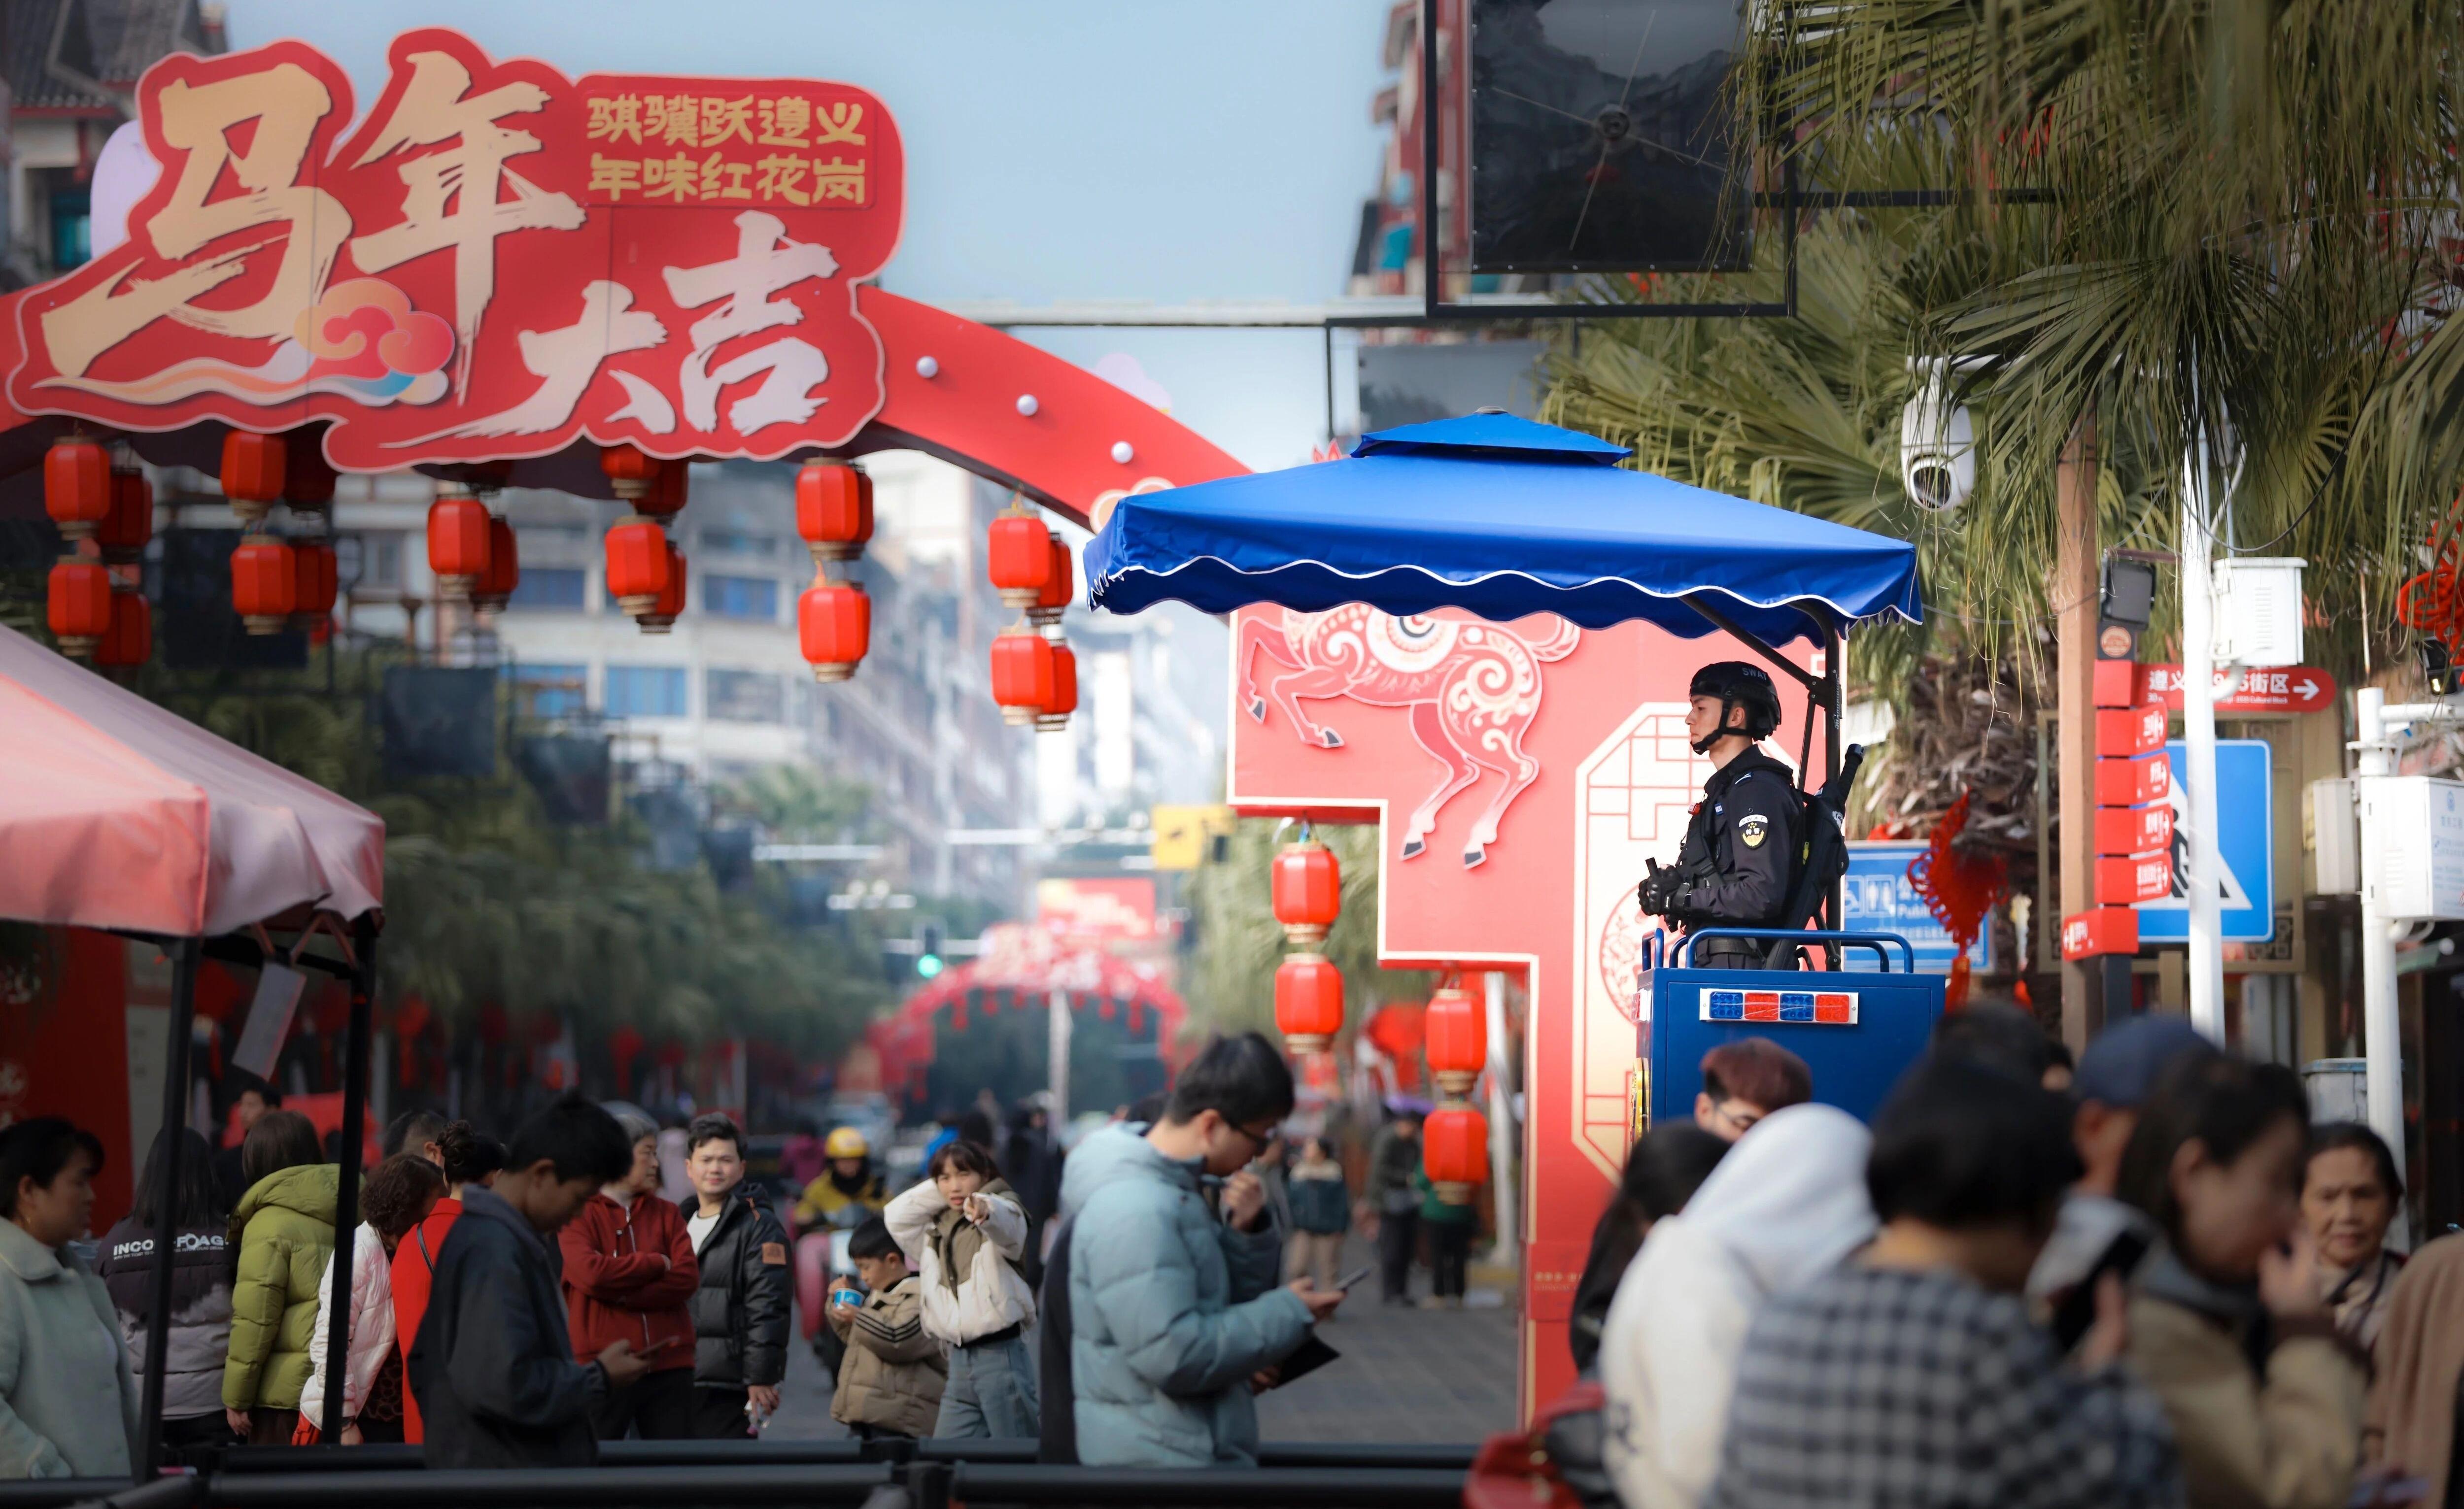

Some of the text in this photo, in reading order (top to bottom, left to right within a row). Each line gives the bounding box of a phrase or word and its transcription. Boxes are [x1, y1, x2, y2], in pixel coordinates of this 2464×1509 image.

[586, 93, 866, 148] 骐骥跃遵义
[588, 151, 865, 205] 年味红花岗
[1742, 668, 1767, 681] SWAT
[113, 1239, 154, 1256] INCO
